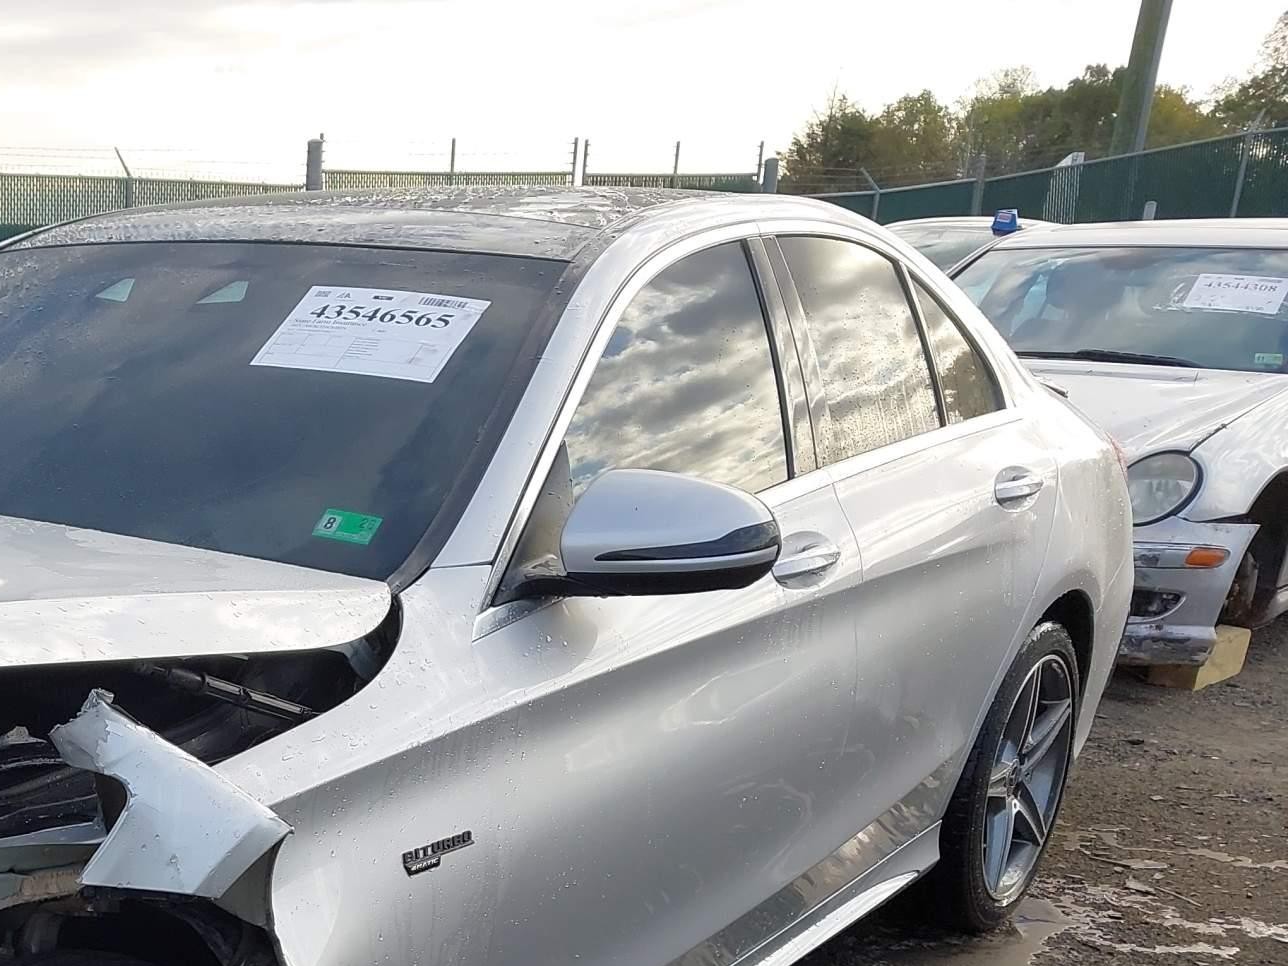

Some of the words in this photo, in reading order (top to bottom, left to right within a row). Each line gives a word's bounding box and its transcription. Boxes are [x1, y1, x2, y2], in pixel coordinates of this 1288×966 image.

[309, 303, 455, 329] 43546565
[323, 516, 337, 530] 8
[402, 830, 472, 864] BITURBO
